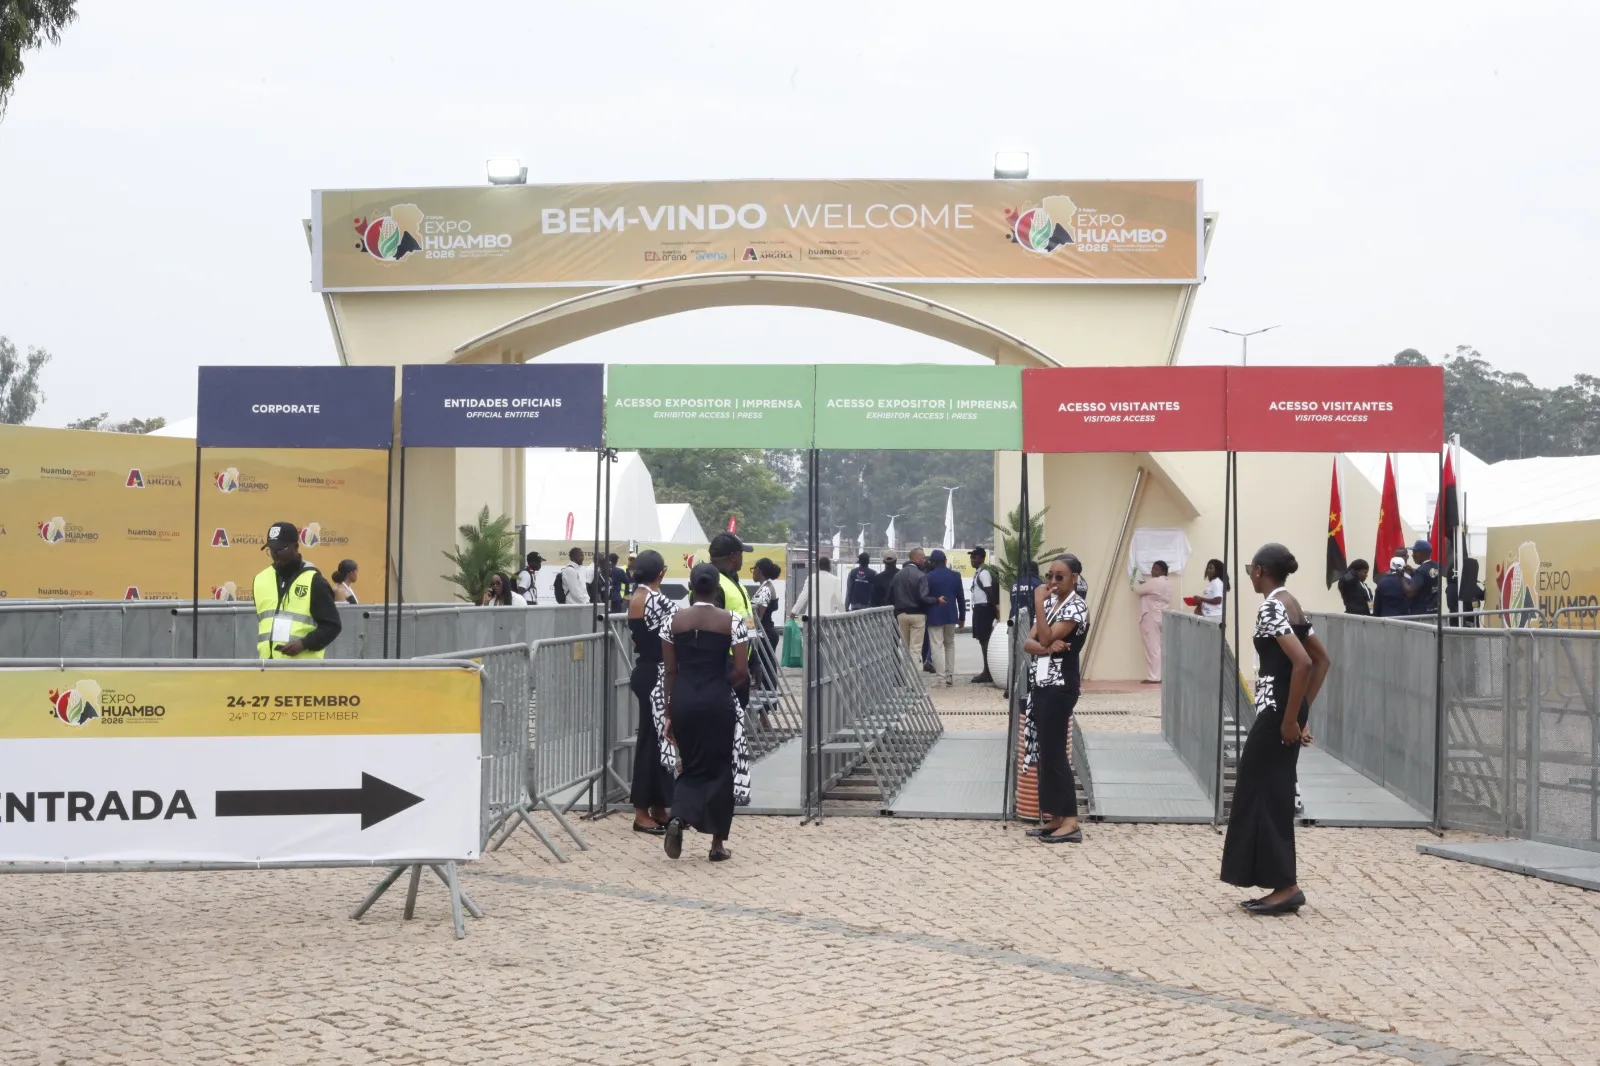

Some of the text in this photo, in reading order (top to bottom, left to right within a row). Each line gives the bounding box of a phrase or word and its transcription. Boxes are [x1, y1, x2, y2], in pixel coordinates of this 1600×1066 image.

[541, 203, 974, 234] BEM-VINDO WELCOME
[1078, 214, 1125, 227] EXPO
[425, 220, 472, 233] EXPO
[1077, 228, 1168, 243] HUAMBO
[425, 234, 513, 249] HUAMBO
[1078, 244, 1108, 252] 2026
[425, 250, 455, 259] 2026
[444, 398, 562, 409] ENTIDADES OFICIAIS
[615, 398, 662, 408] ACESSO
[665, 399, 732, 408] EXPOSITOR
[742, 399, 803, 409] IMPRENSA
[826, 399, 874, 408] ACESSO
[878, 399, 946, 409] EXPOSITOR
[957, 400, 1018, 409] IMPRENSA
[1058, 401, 1181, 412] ACESSO VISITANTES
[1269, 401, 1394, 412] ACESSO VISITANTES
[252, 404, 320, 414] CORPORATE
[466, 411, 540, 419] OFFICIAL ENTITIES
[653, 411, 697, 419] EXHIBITOR
[699, 411, 730, 419] ACCESS
[912, 412, 944, 420] ACCESS
[951, 412, 978, 420] PRESS
[1083, 415, 1121, 423] VISITORS
[1294, 414, 1368, 422] VISITORS ACCESS
[40, 466, 96, 477] huambo.gov.ao
[146, 478, 182, 487] ANGOLA
[65, 532, 99, 540] HUAMBO
[231, 537, 265, 545] ANGOLA
[1540, 571, 1571, 590] EXPO
[38, 587, 94, 596] huambo.gov.ao
[1539, 595, 1599, 618] HUAMBO
[101, 694, 136, 704] EXPO
[227, 695, 361, 707] 24-27 SETEMBRO
[101, 705, 165, 717] HUAMBO
[252, 712, 267, 721] TO
[292, 711, 359, 721] SEPTEMBER
[101, 717, 123, 725] 2026
[0, 789, 198, 823] NTRADA
